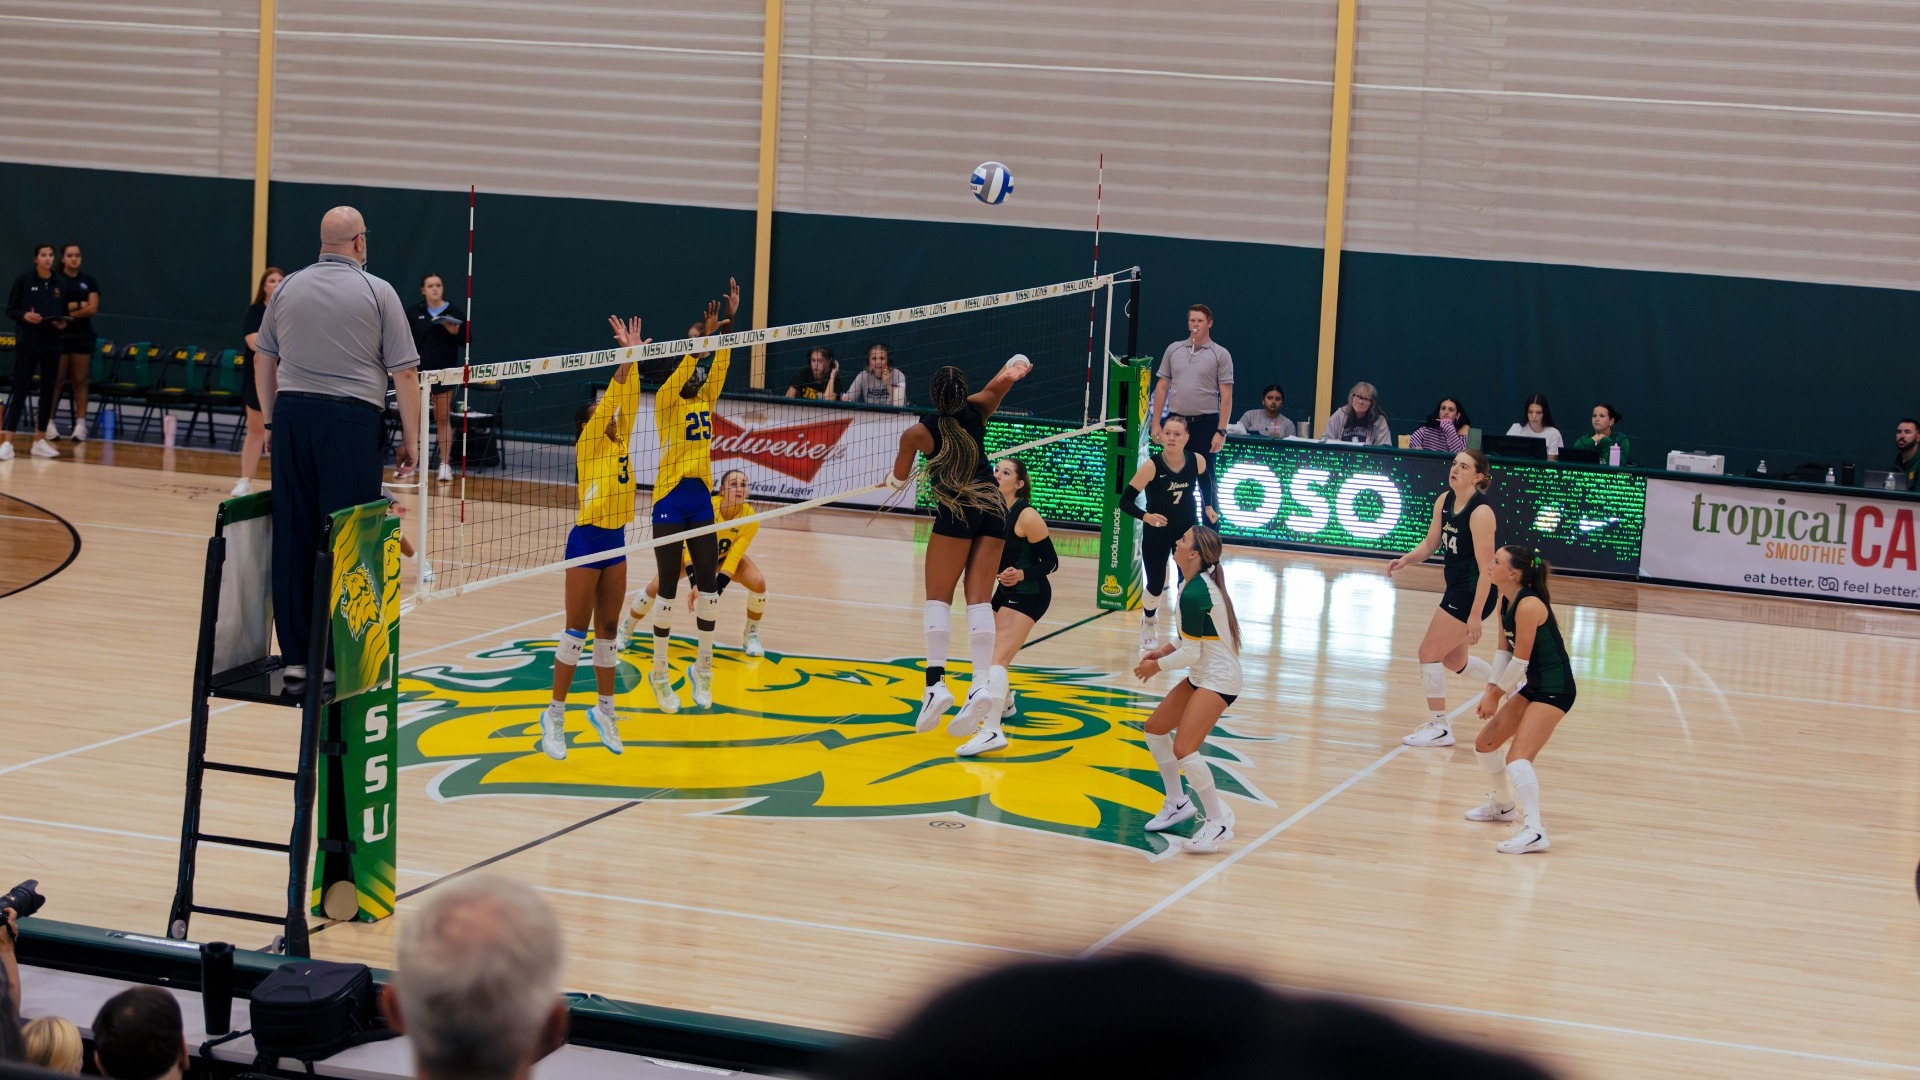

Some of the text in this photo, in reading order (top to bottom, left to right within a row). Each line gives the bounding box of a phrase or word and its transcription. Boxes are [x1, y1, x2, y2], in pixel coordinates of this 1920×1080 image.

[909, 303, 947, 319] MSSU LIONS
[786, 321, 830, 337] MSSU LIONS
[851, 313, 891, 328] MSSU LIONS
[718, 329, 765, 347] MSSU LIONS
[642, 339, 694, 357] MSSU LIONS
[560, 350, 616, 368] MSSU LIONS
[470, 361, 532, 379] MSSU LIONS
[686, 411, 711, 440] 25
[711, 431, 847, 461] udweiser
[618, 456, 629, 484] 3
[780, 484, 813, 497] Lager
[1173, 491, 1183, 504] 7
[1691, 493, 1847, 545] tropical
[1111, 508, 1121, 568] sports imports
[1765, 541, 1846, 565] SMOOTHIE
[1744, 573, 1918, 597] eat better. feel better.
